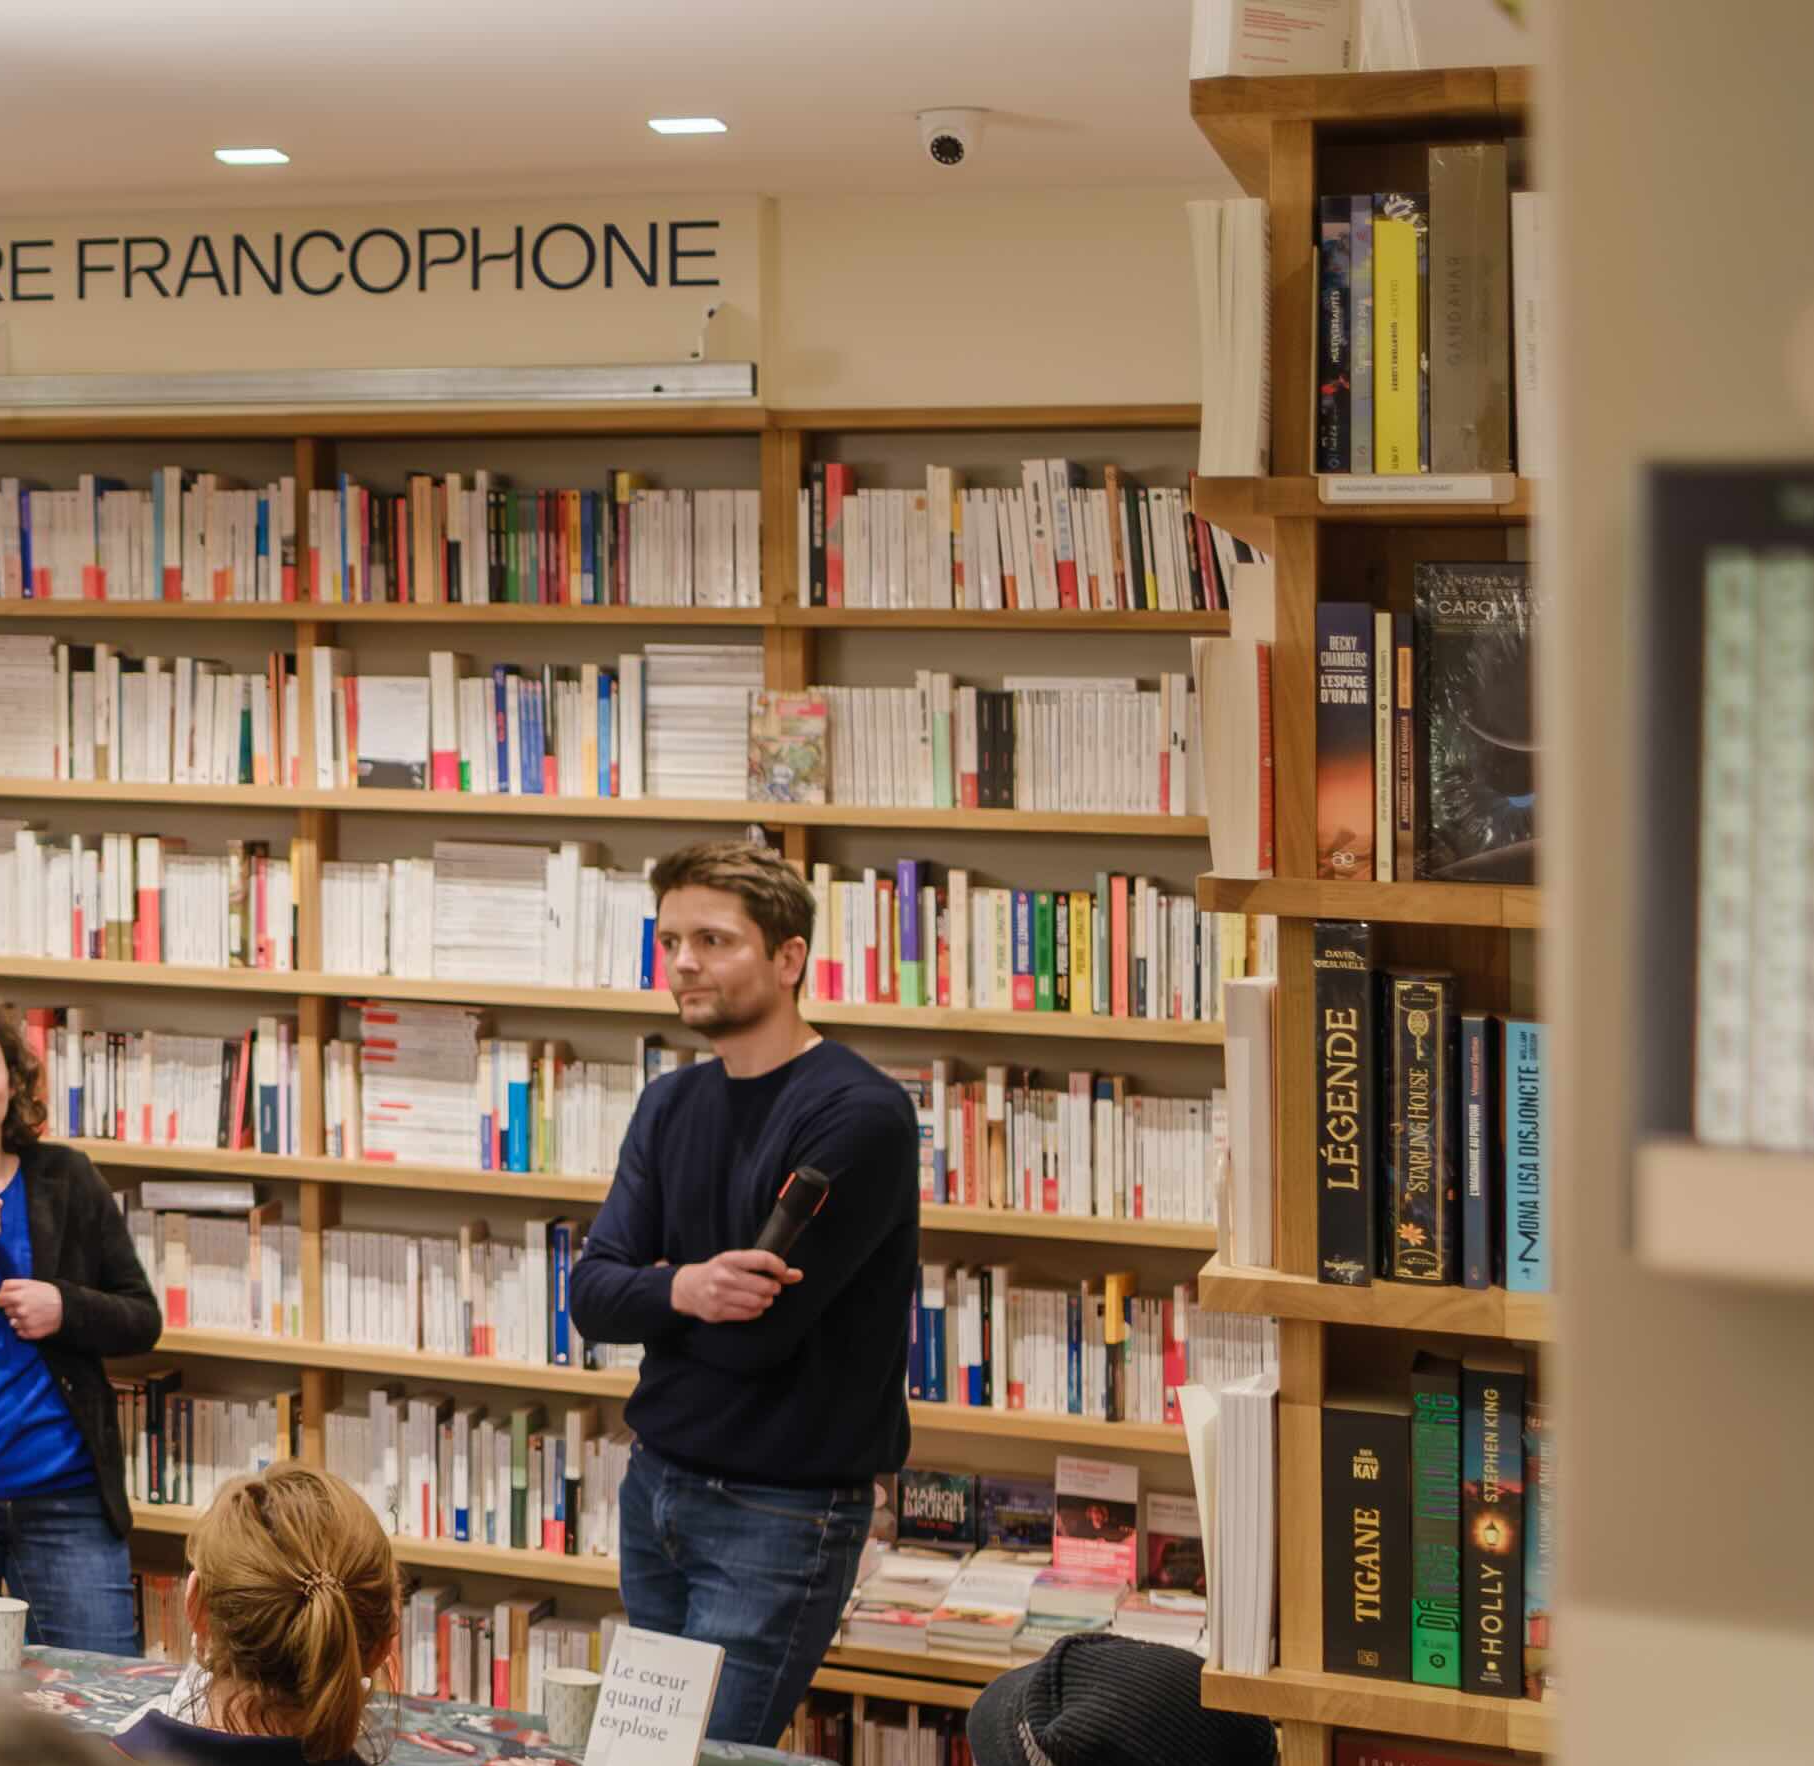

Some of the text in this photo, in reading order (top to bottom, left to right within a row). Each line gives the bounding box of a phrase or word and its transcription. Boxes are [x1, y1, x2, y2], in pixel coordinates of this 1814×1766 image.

[76, 220, 721, 301] FRANCOPHONE
[1329, 635, 1358, 651] BECKY
[1320, 651, 1368, 668] CHAMBERS
[1320, 674, 1368, 689] L'ESPACE
[1320, 689, 1368, 704] D'UN AN
[1324, 950, 1356, 960] DAVID
[1320, 1007, 1360, 1192] LÉGENDE
[1406, 1067, 1429, 1194] STARLING HOUSE
[1469, 1104, 1480, 1136] POUVOIR
[1469, 1137, 1480, 1148] AU
[1516, 1065, 1541, 1264] MONA LISA DISJONCTE
[1483, 1388, 1500, 1504] STEPHEN KING
[1353, 1464, 1379, 1480] KAY
[904, 1487, 965, 1504] MARION
[903, 1502, 967, 1524] BRUNET
[1355, 1507, 1381, 1624] TIGANE
[1480, 1563, 1504, 1655] HOLLY
[612, 1658, 690, 1692] Le cœur
[604, 1688, 683, 1717] quand il
[599, 1713, 670, 1742] explose
